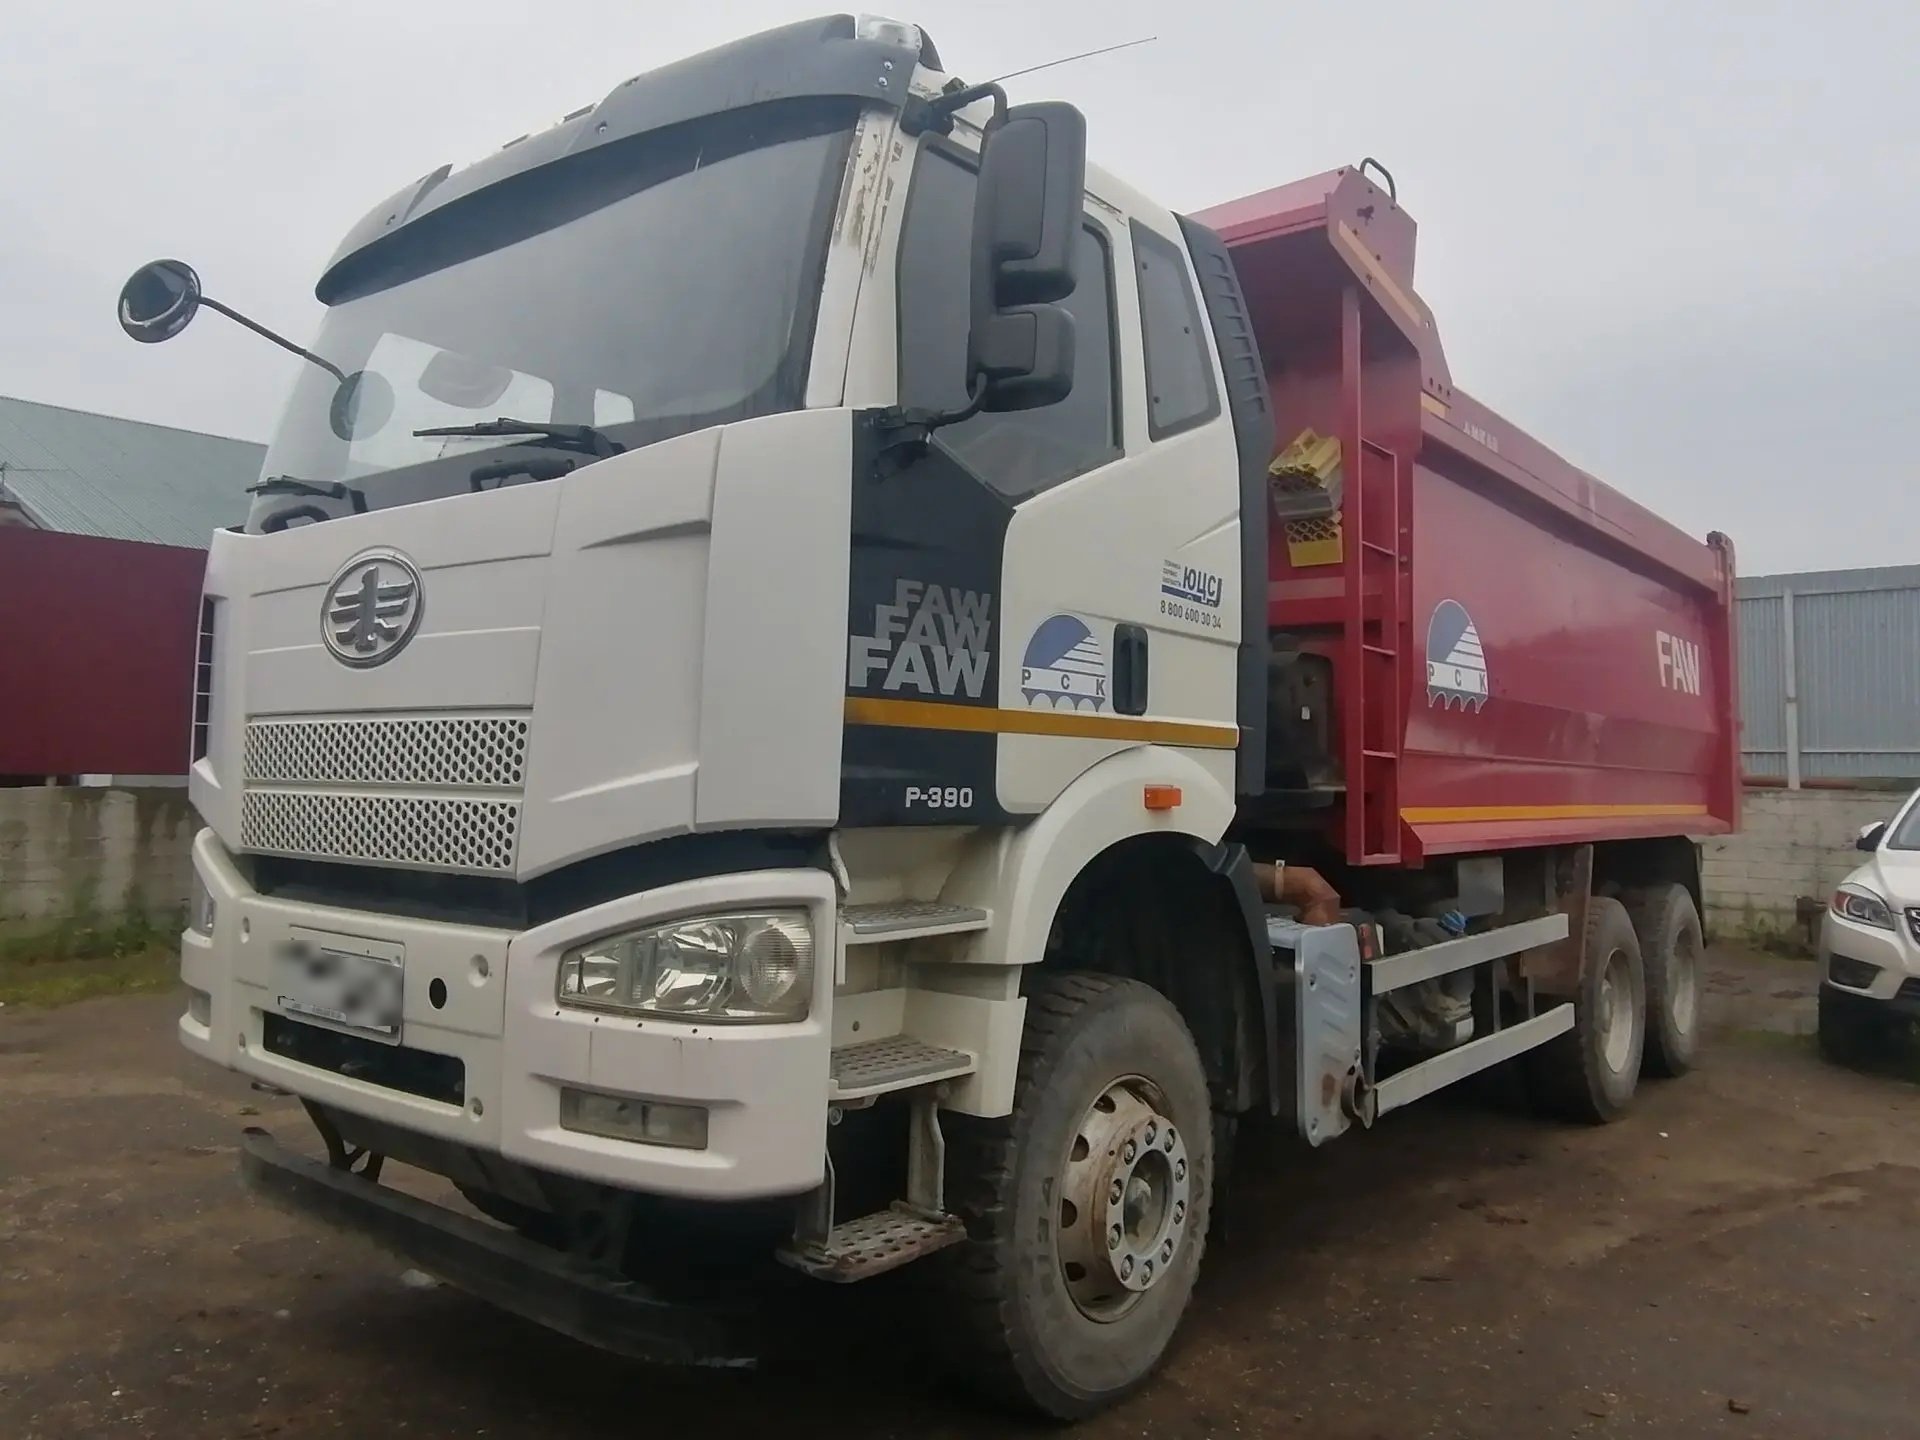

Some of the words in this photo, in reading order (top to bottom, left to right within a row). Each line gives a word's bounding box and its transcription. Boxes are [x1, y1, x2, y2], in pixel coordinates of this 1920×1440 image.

[895, 578, 992, 626] FAW
[1160, 600, 1166, 614] 8
[1167, 601, 1183, 618] 800
[1185, 607, 1200, 623] 600
[1201, 612, 1211, 627] 30
[875, 603, 992, 659] FAW
[849, 634, 991, 698] FAW
[1656, 630, 1701, 696] FAW
[905, 786, 973, 808] P-390
